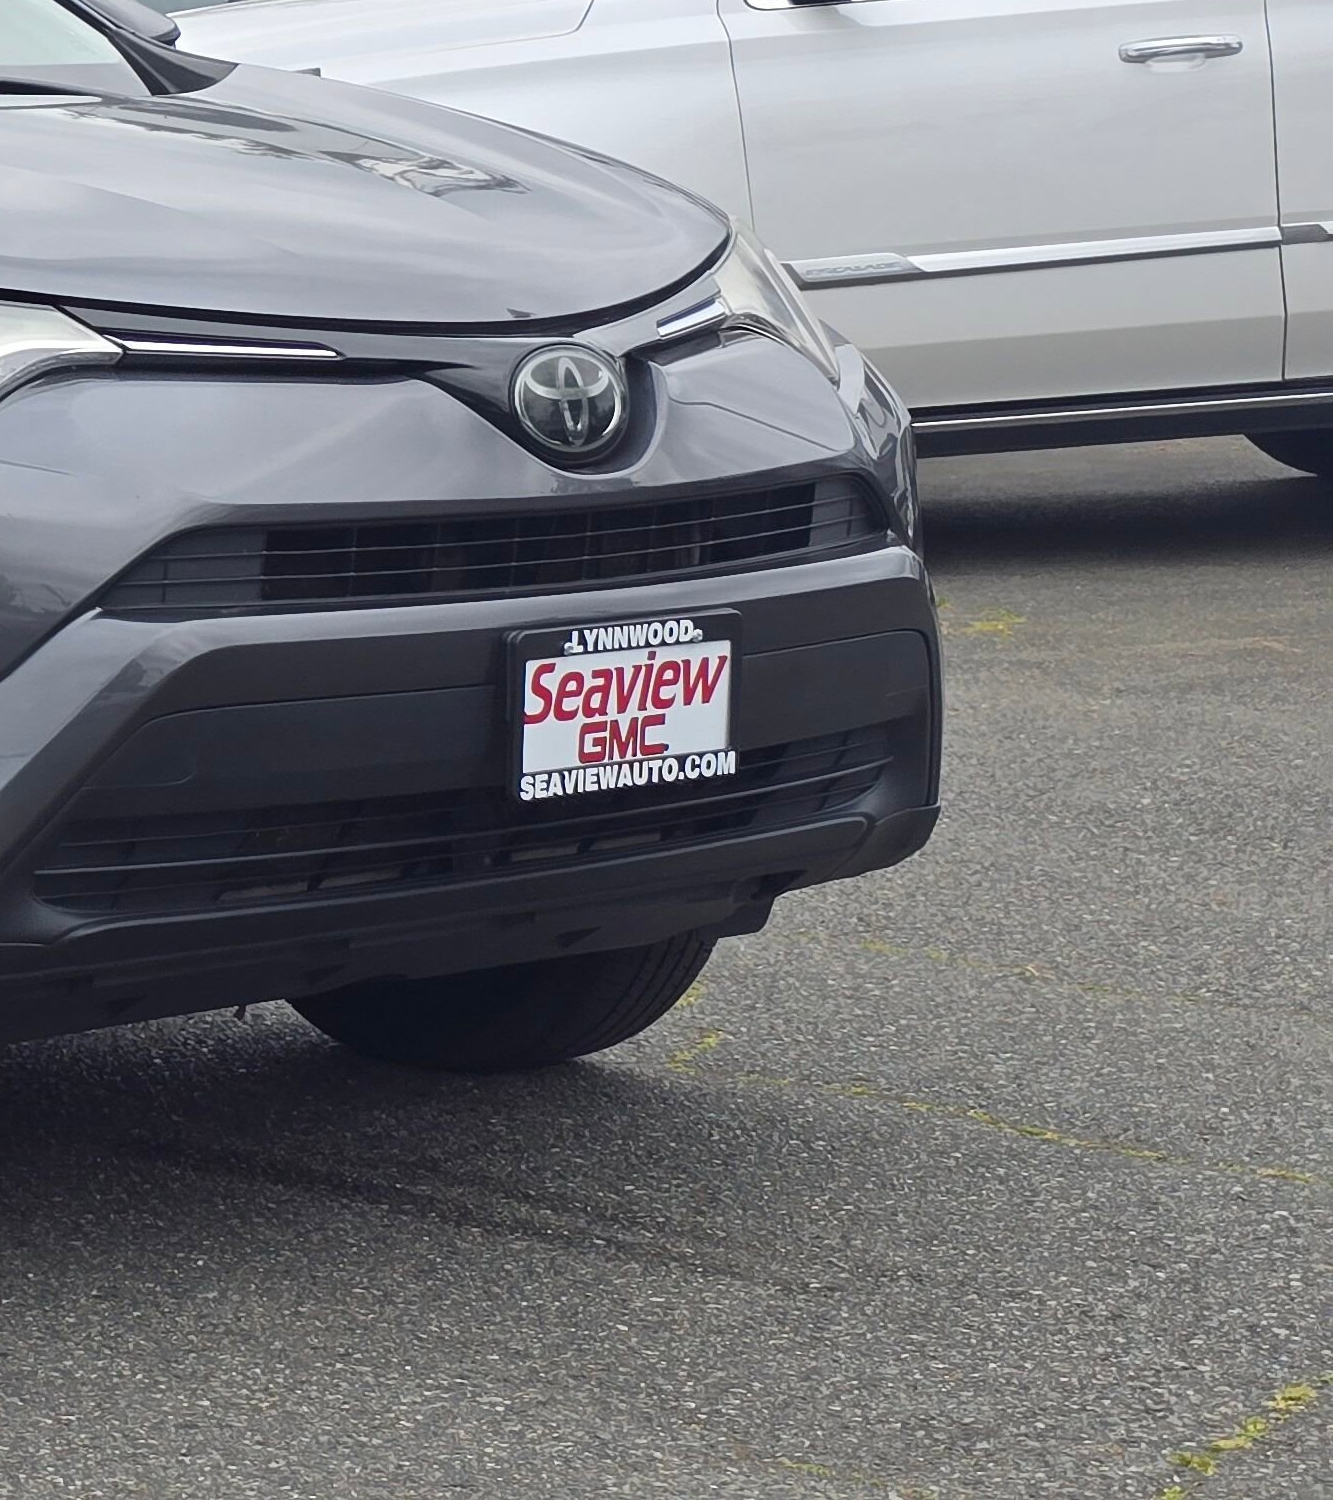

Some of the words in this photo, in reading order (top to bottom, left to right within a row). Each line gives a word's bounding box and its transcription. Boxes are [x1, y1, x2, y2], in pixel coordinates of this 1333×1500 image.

[569, 619, 694, 653] LYNNWOOD
[523, 650, 728, 725] Seaview
[578, 713, 669, 765] GMC
[519, 751, 736, 801] SEAVIEWAUTO.COM
